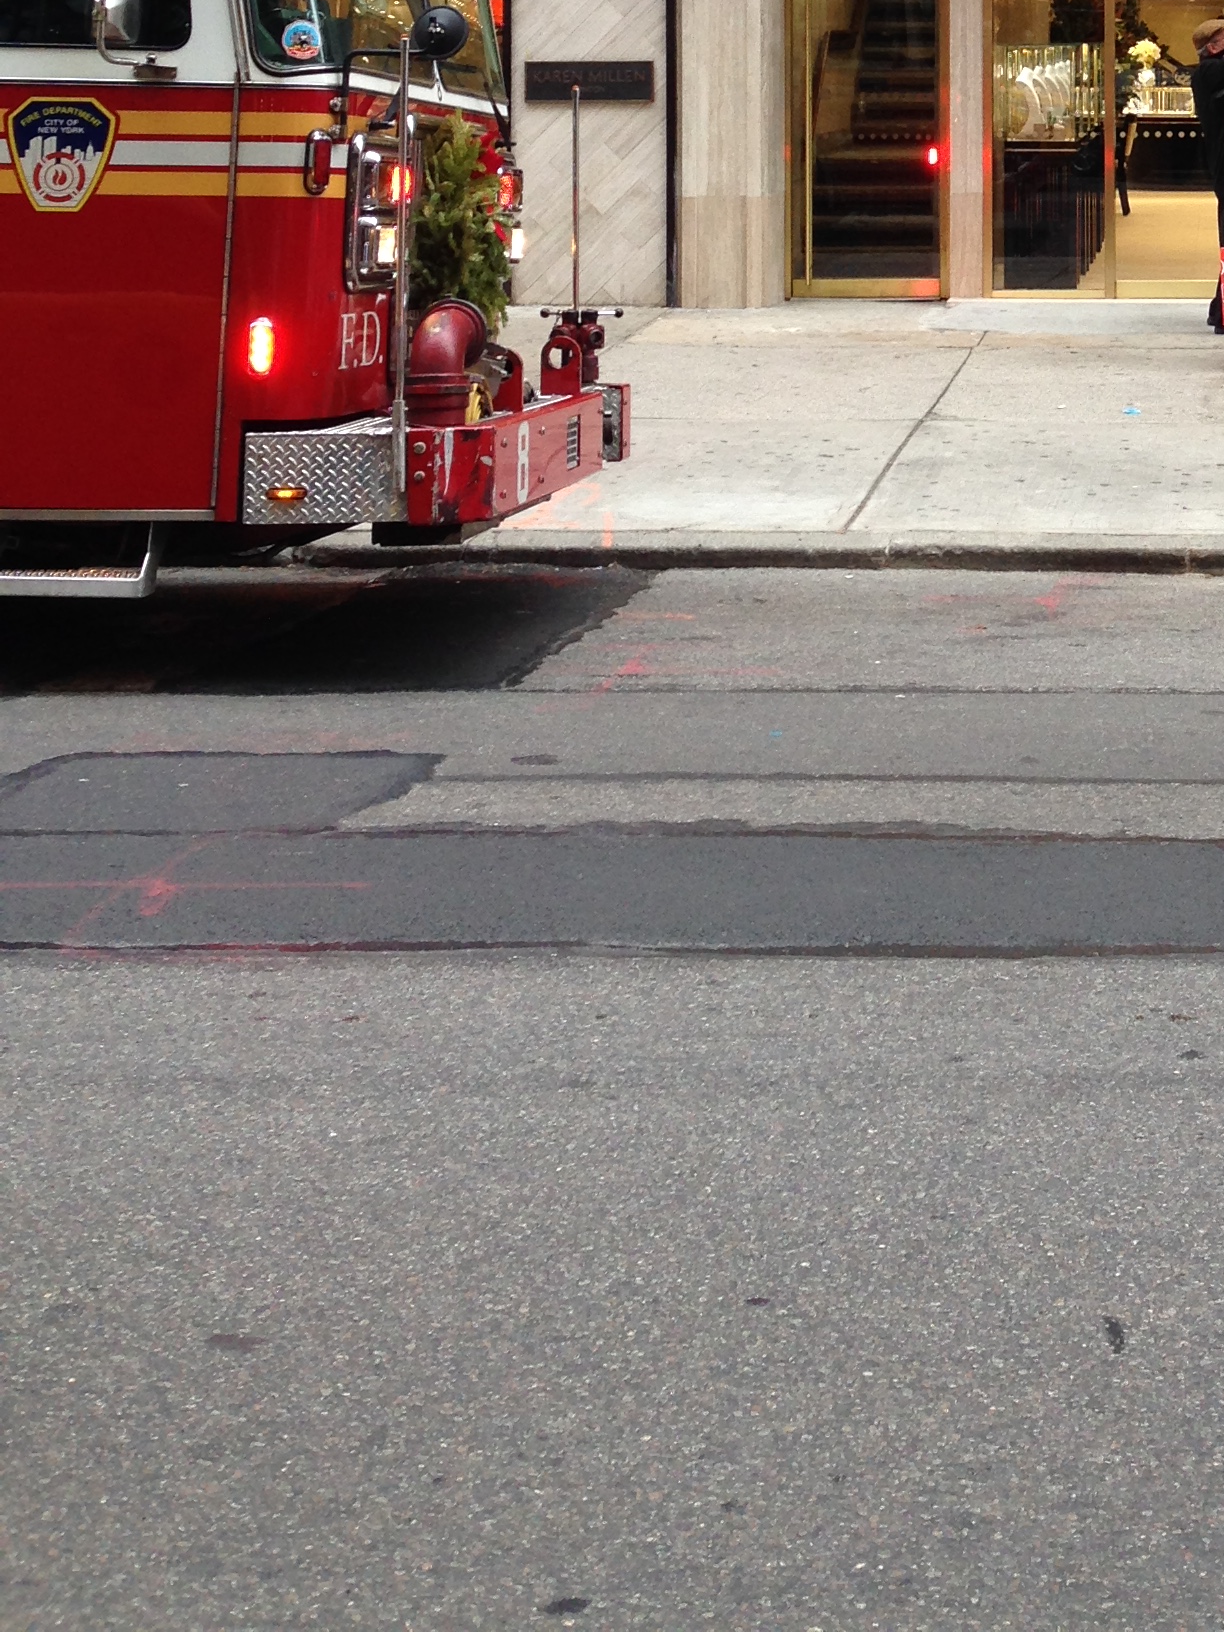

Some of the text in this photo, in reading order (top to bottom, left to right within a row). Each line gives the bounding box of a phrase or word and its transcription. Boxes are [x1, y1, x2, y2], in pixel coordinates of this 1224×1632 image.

[587, 69, 646, 83] MILLEN
[20, 106, 102, 127] FIRE DEPARTMENT
[44, 118, 80, 127] CITY OF
[516, 421, 530, 505] 8
